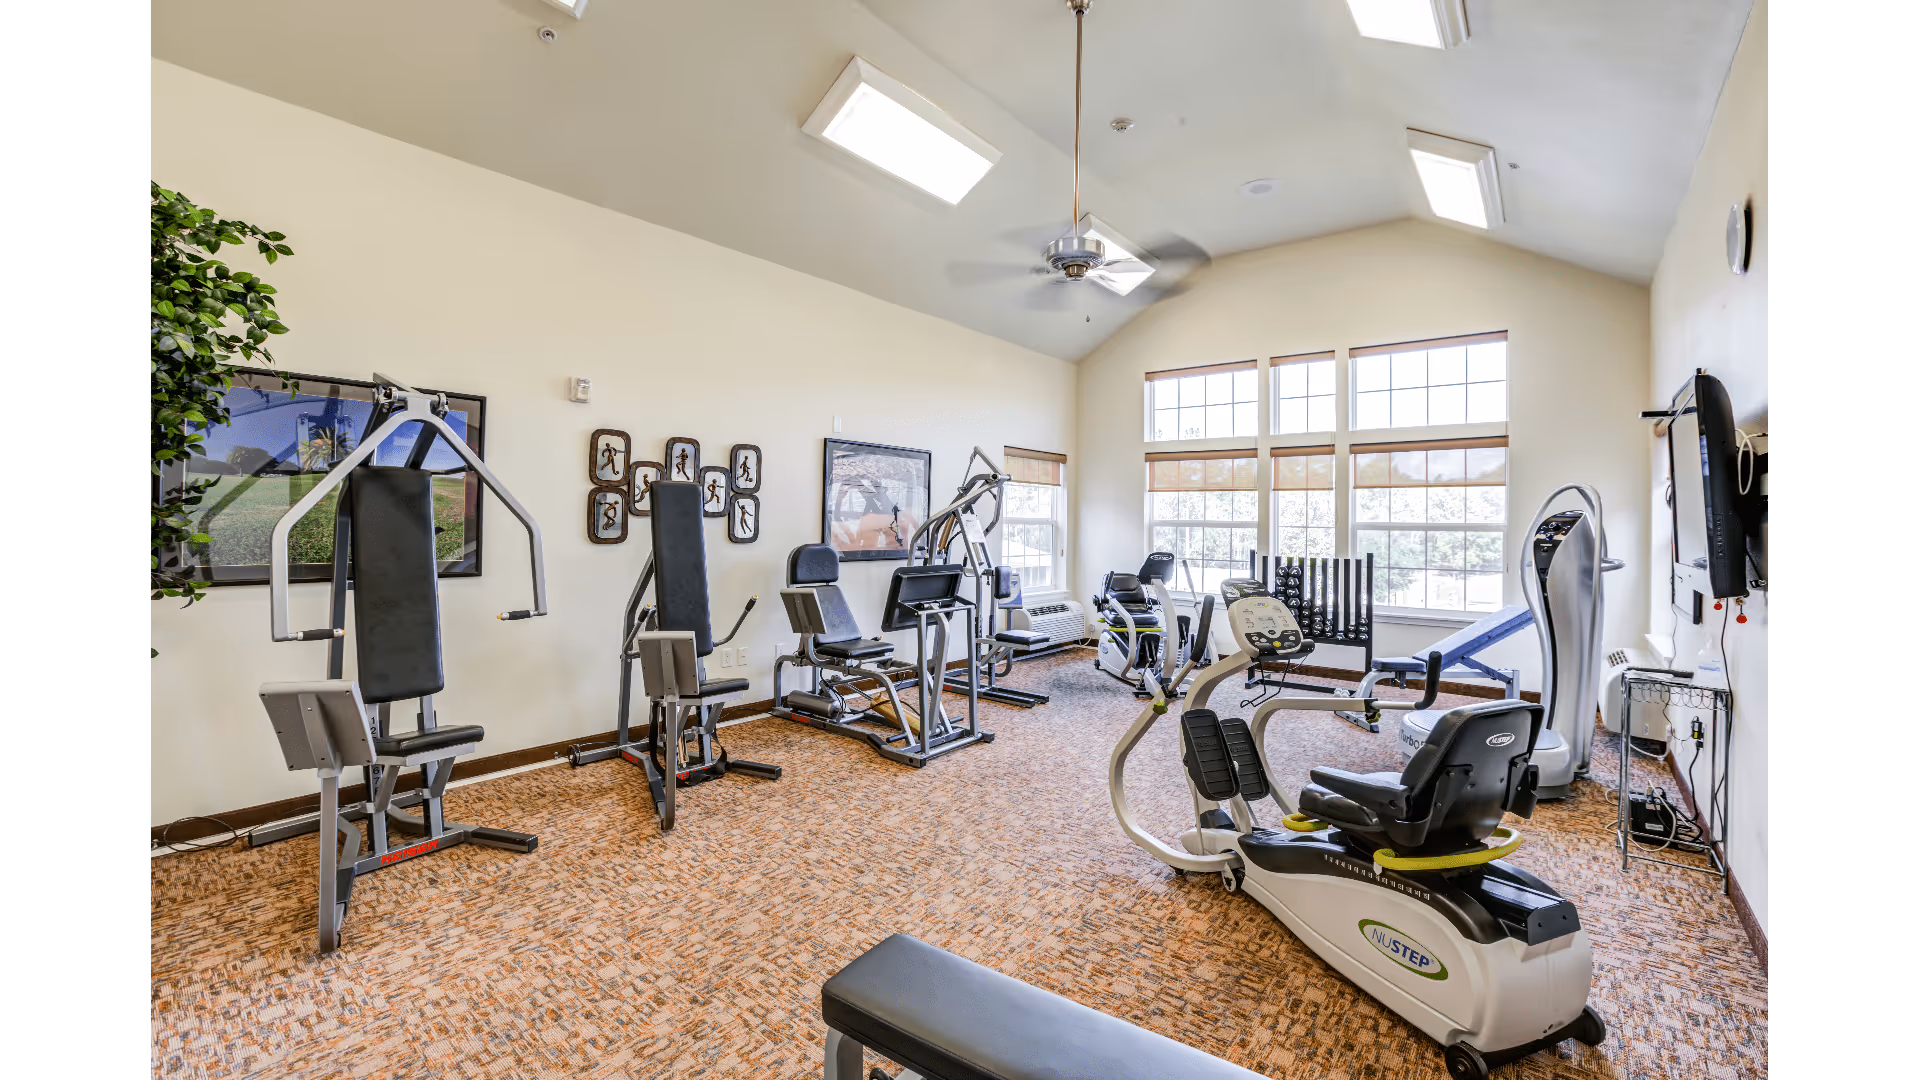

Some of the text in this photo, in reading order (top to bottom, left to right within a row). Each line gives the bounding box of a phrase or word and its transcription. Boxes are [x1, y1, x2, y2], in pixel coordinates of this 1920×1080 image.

[370, 726, 376, 735] 2
[373, 766, 380, 775] 6
[380, 839, 439, 866] KEISER
